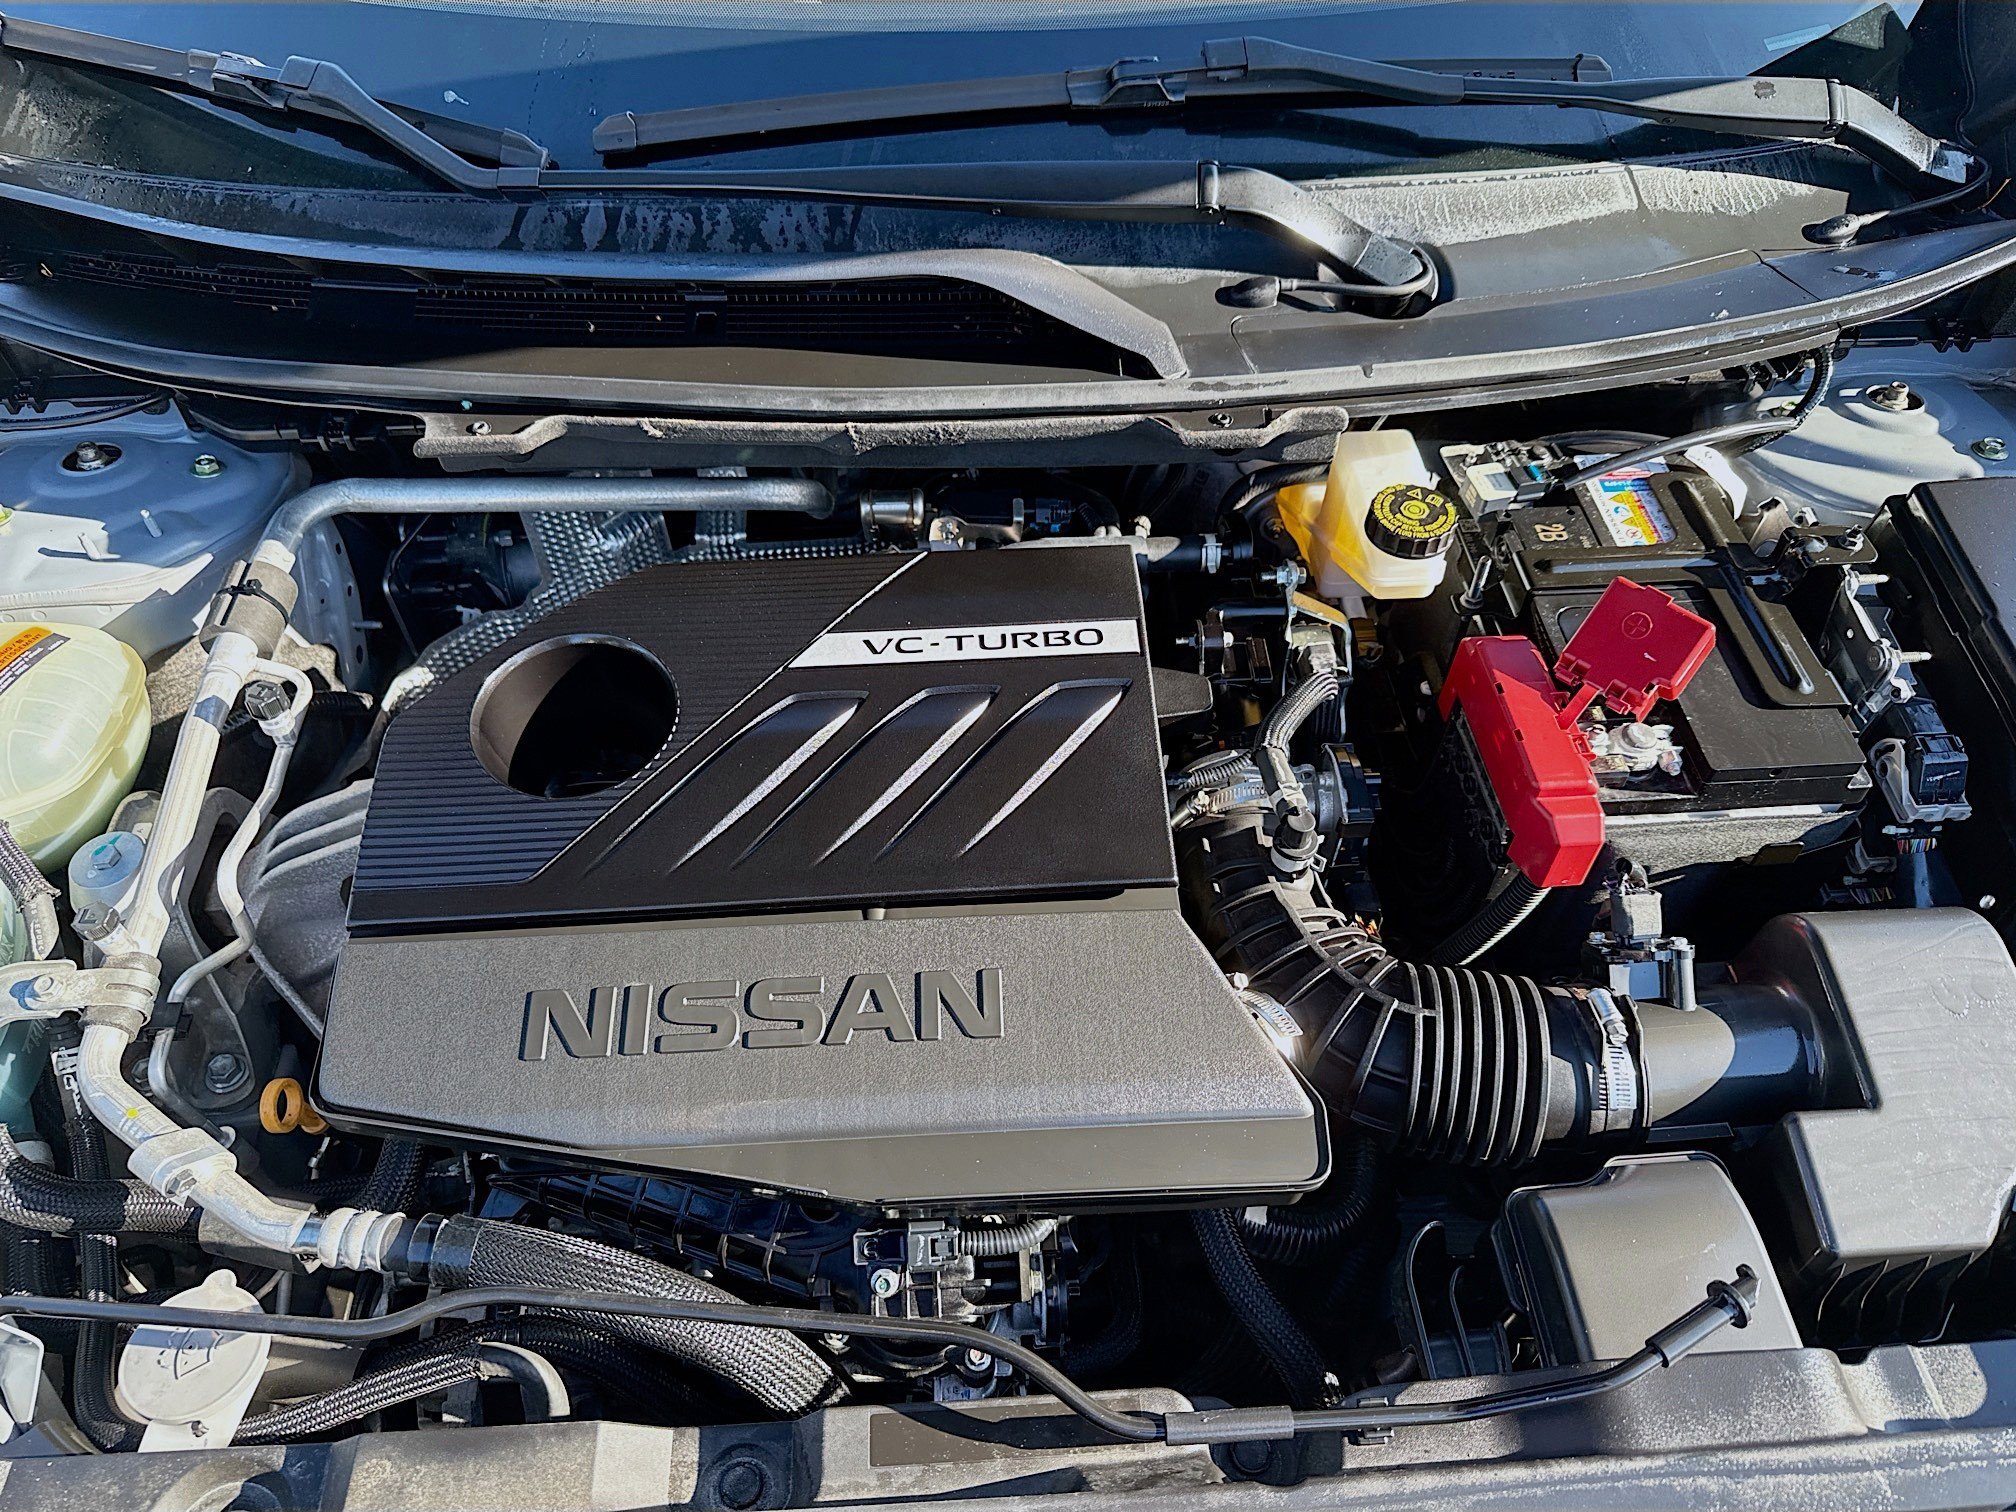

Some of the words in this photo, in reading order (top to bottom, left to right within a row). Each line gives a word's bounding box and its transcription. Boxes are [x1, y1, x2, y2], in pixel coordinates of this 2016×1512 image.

[1534, 523, 1568, 542] 2B
[862, 628, 1104, 655] VC-TURBO
[518, 968, 1004, 1062] NISSAN
